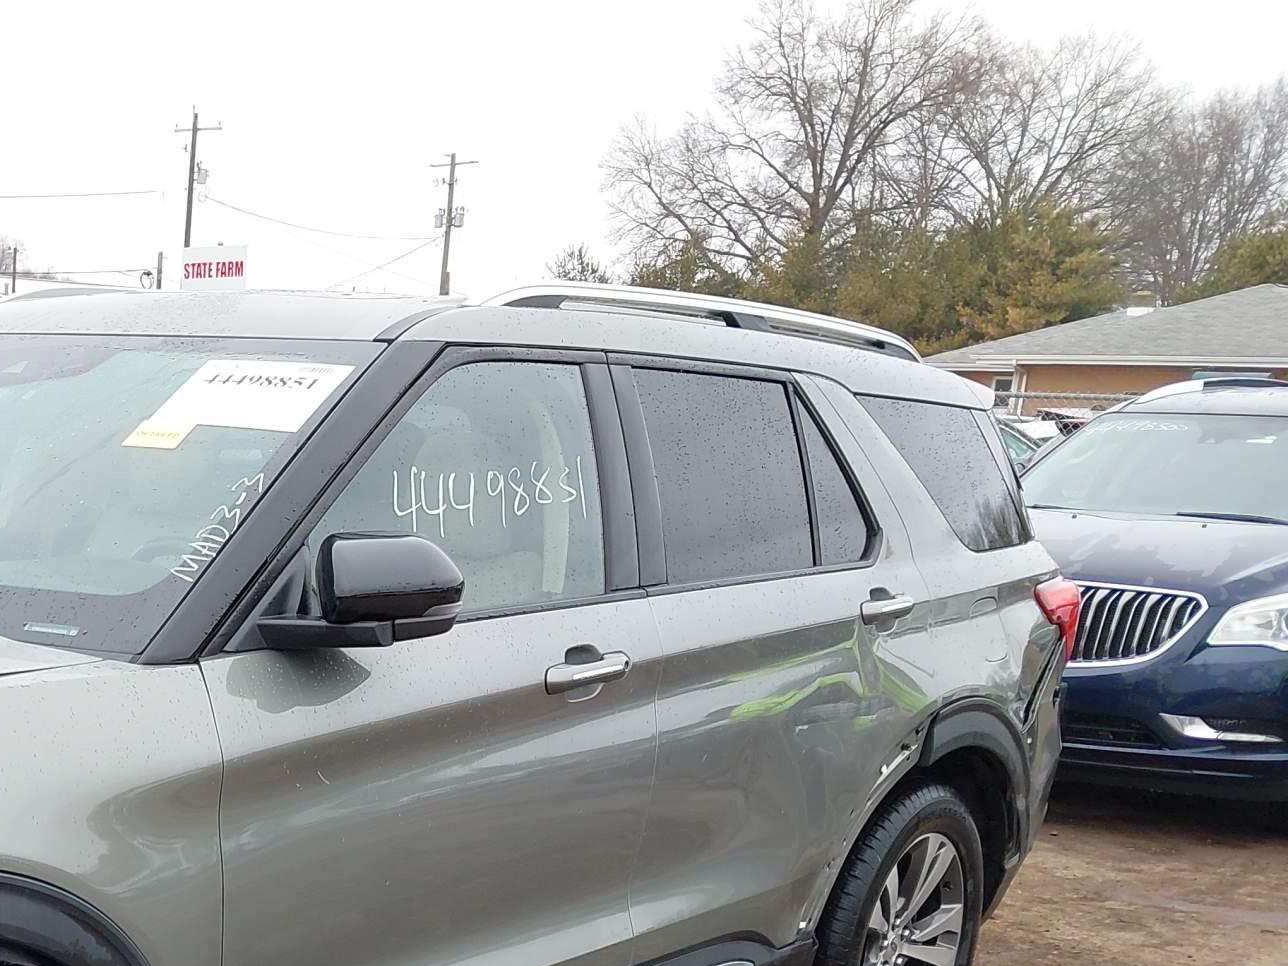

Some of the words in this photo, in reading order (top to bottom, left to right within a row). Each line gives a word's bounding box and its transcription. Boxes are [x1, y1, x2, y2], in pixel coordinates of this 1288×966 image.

[184, 261, 213, 279] STATE
[215, 260, 244, 278] FARM
[202, 373, 320, 391] 44498851
